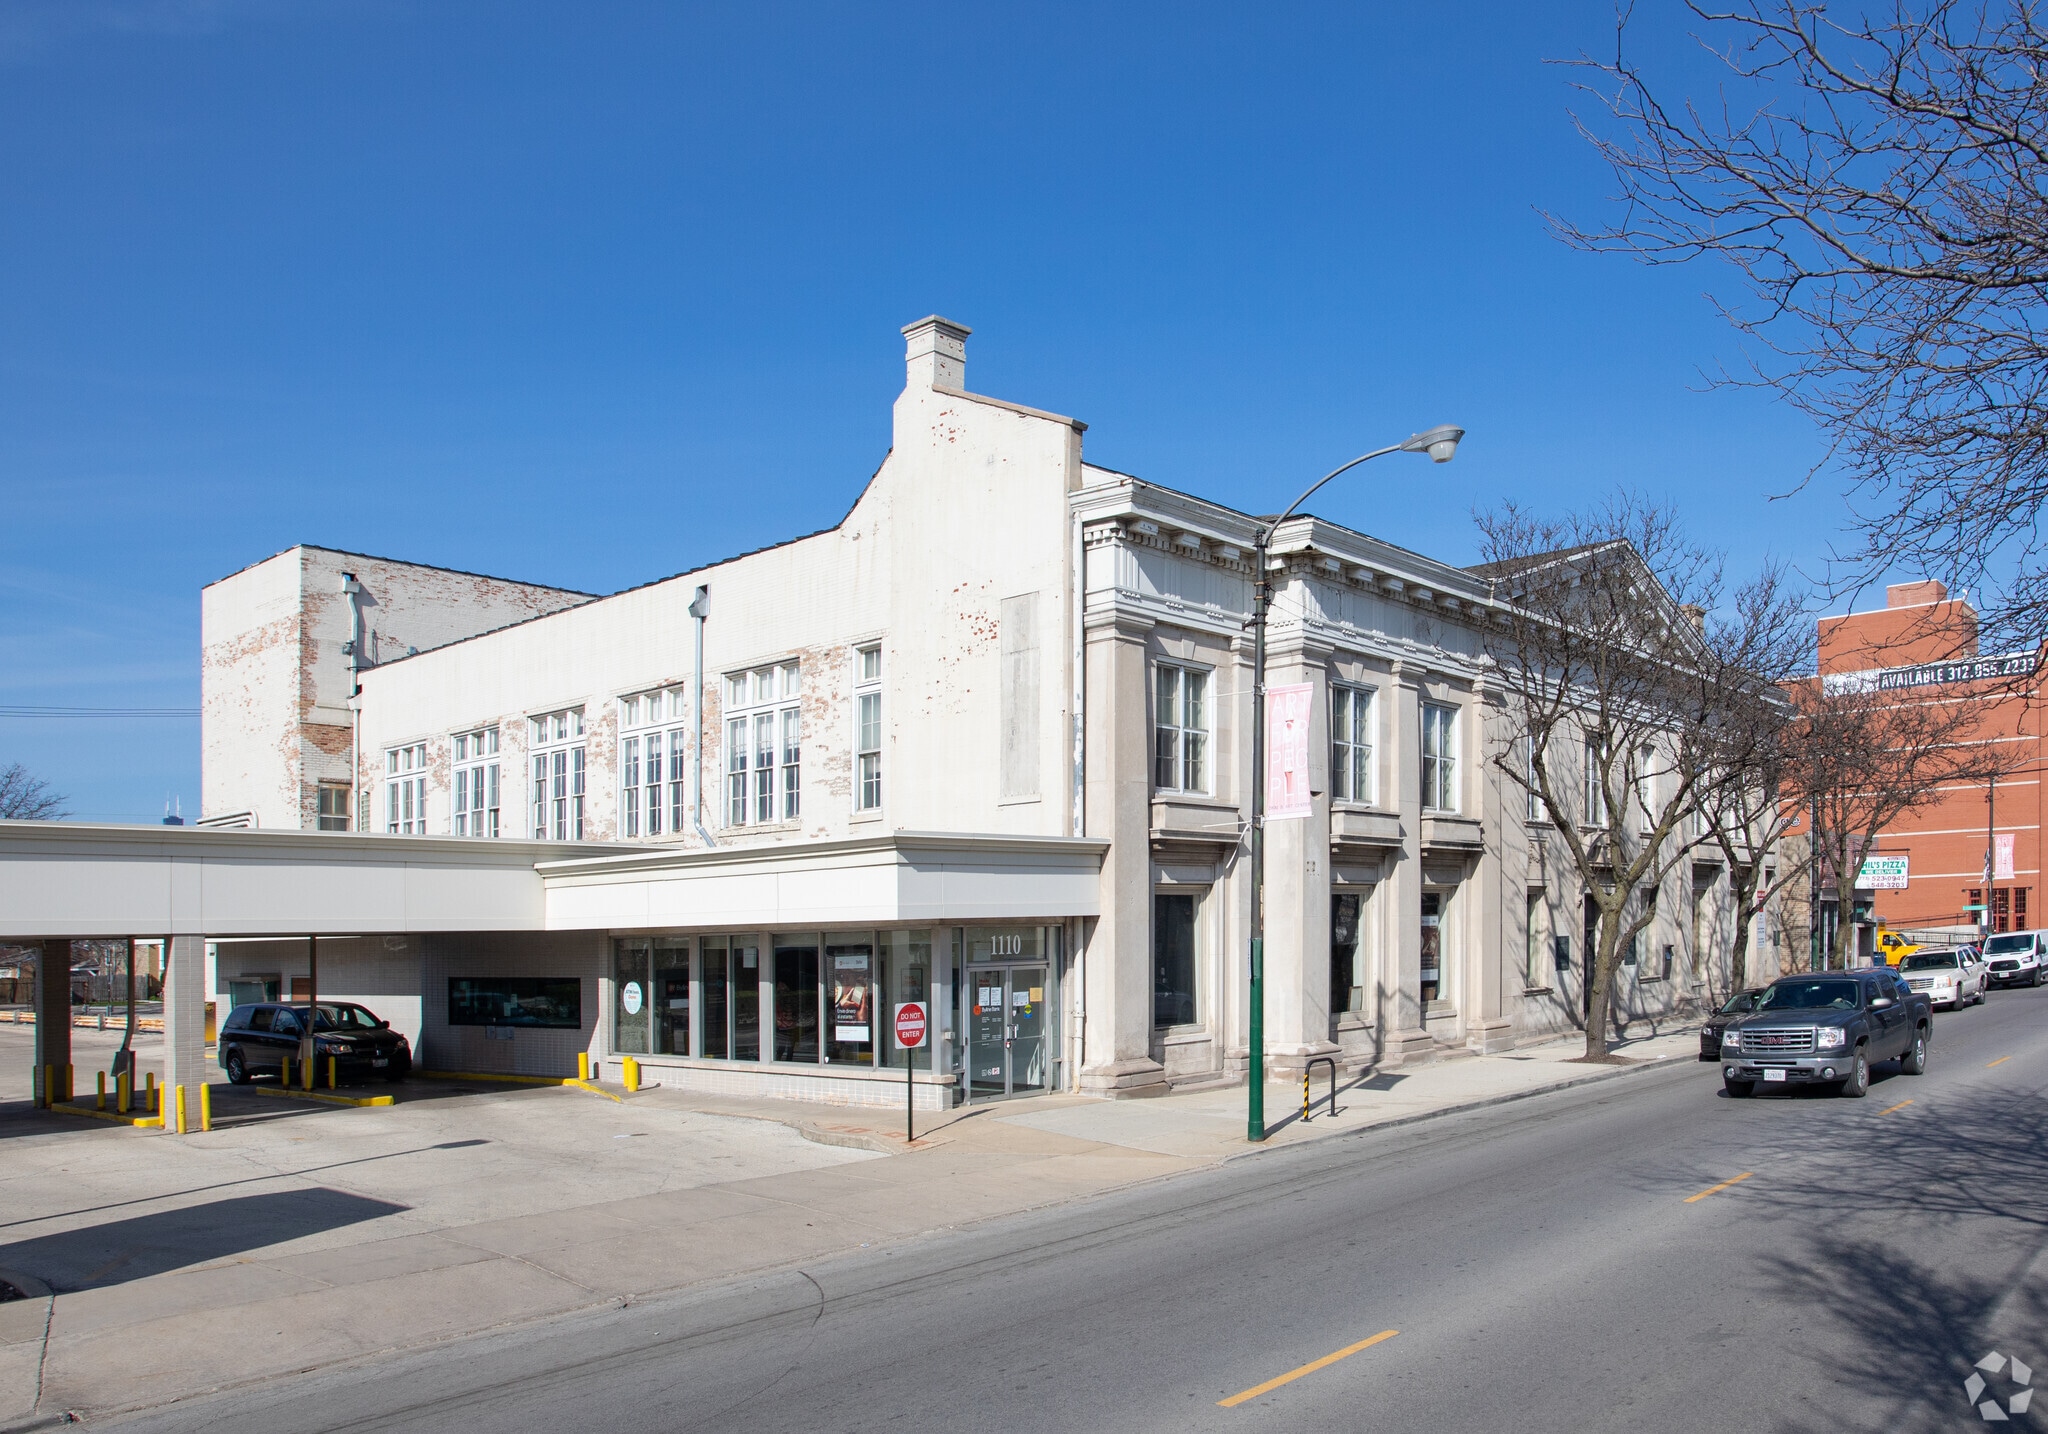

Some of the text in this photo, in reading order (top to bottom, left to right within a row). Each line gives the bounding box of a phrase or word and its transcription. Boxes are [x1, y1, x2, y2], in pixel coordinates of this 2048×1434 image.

[1881, 669, 1944, 688] AVAILABLE
[1271, 692, 1310, 715] ART
[1270, 774, 1308, 800] PLE
[1862, 860, 1906, 869] HIL'S PIZZA
[991, 934, 1021, 955] 1110
[902, 1030, 920, 1038] ENTER
[1760, 1036, 1791, 1044] GMC
